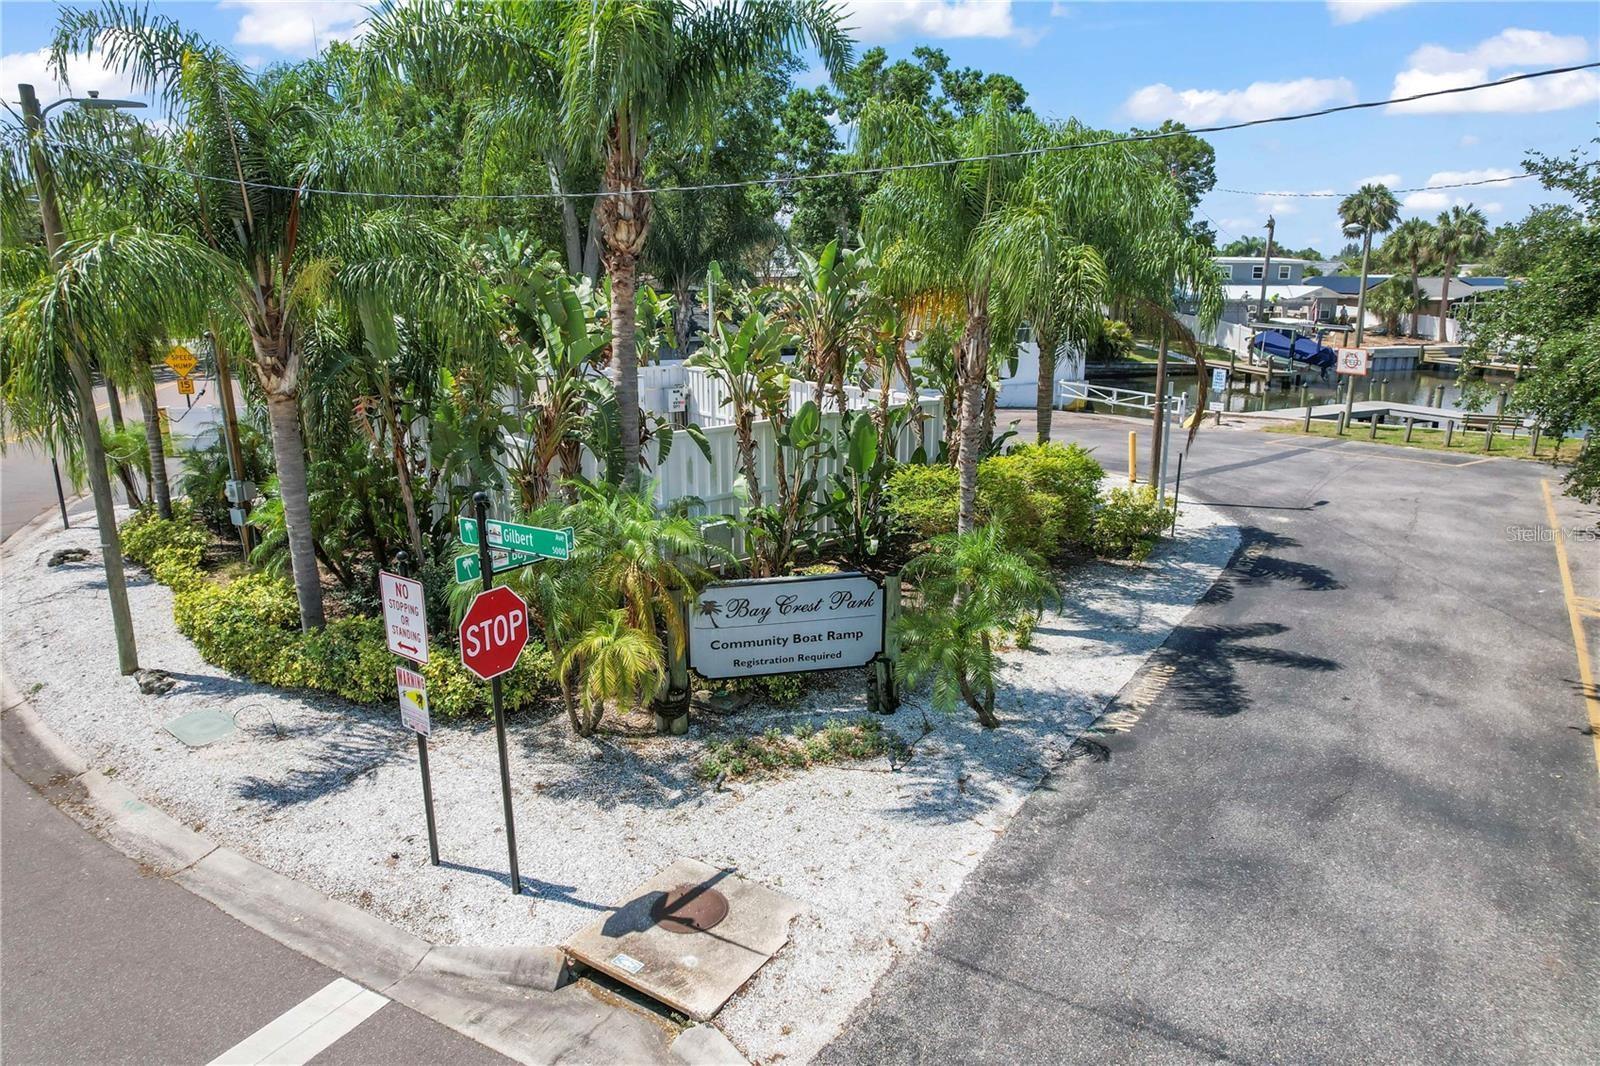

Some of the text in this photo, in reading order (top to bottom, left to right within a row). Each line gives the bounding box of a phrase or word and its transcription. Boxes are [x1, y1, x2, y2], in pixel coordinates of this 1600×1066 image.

[180, 381, 191, 389] 15
[503, 529, 534, 547] Gilbert
[395, 582, 409, 599] NO
[388, 598, 419, 617] STOPPING
[725, 590, 876, 623] Bay Crest Park
[400, 615, 409, 626] OR
[391, 625, 421, 643] STANDING
[466, 609, 523, 657] STOP
[710, 630, 864, 650] Community Boat Ramp
[733, 650, 842, 668] Registration Required
[396, 668, 425, 690] WARNING
